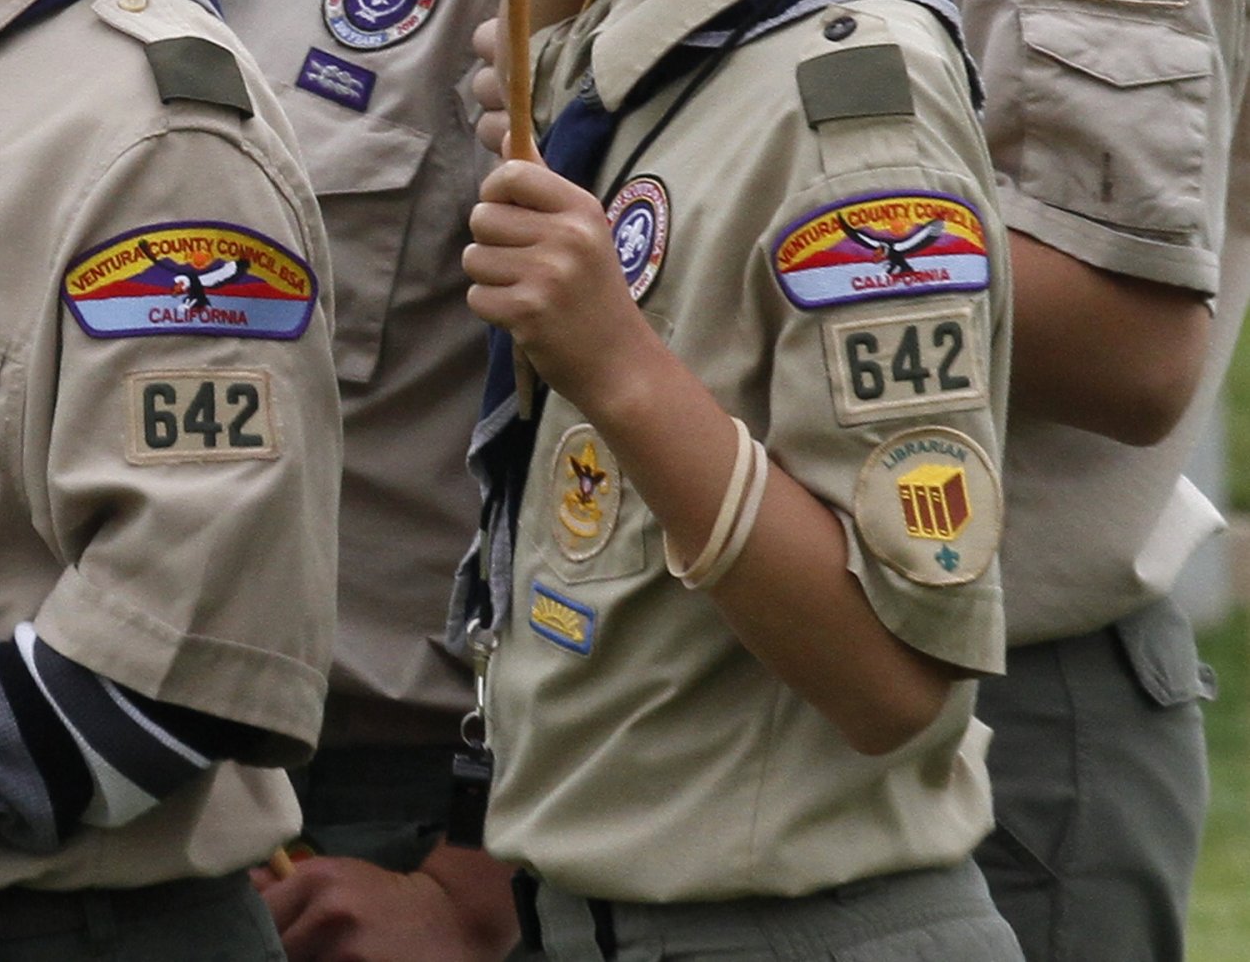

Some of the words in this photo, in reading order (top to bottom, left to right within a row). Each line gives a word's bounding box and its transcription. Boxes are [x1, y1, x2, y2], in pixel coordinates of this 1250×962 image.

[779, 215, 846, 265] VENTURA
[847, 203, 912, 227] COUNTY
[71, 245, 147, 291] VENTURA
[148, 237, 214, 258] COUNTY
[217, 239, 278, 276] COUNCIL
[278, 265, 306, 294] BSA
[851, 268, 951, 290] CALIFORNIA
[148, 307, 249, 327] CALIFORNIA
[845, 320, 971, 400] 642
[142, 381, 264, 449] 642
[881, 439, 968, 470] LIBRARIAN
